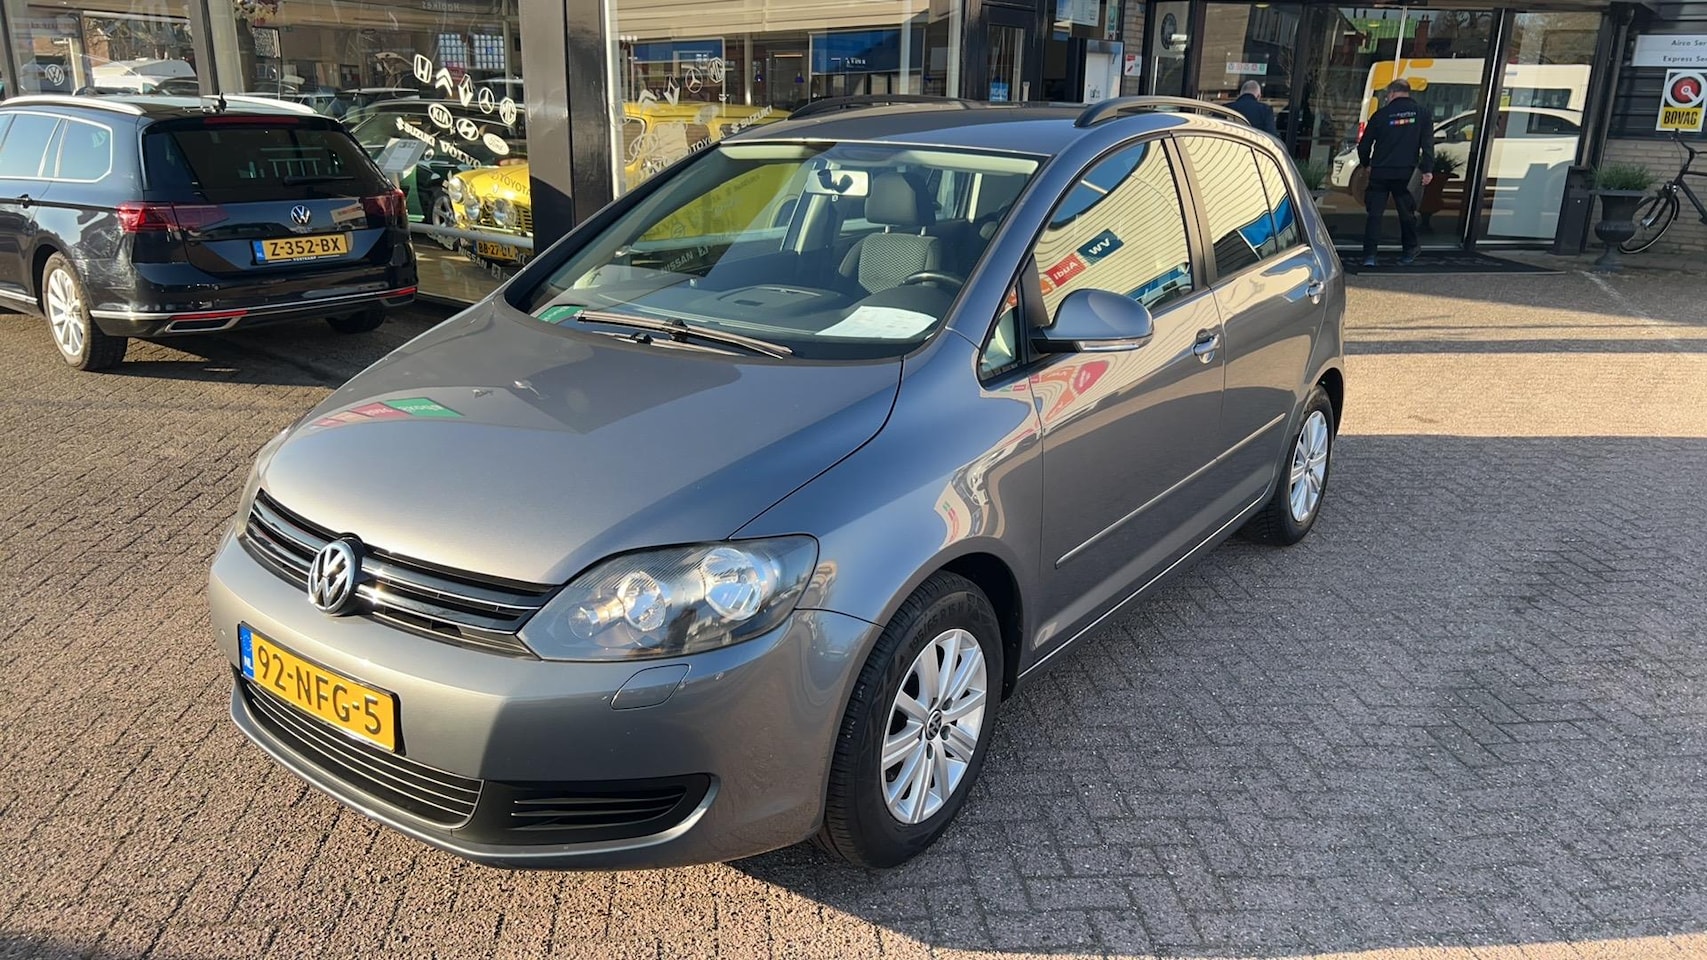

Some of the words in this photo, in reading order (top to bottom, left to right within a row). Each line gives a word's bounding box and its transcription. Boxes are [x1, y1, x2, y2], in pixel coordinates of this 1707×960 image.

[430, 106, 451, 125] KIA
[500, 99, 517, 123] MG
[741, 105, 773, 128] SUZUKI
[1663, 110, 1698, 126] BOVAG
[403, 122, 435, 147] SUZUKI
[439, 139, 481, 168] VOLVO
[270, 238, 341, 257] Z-352-BX
[243, 655, 254, 670] NL
[258, 645, 381, 735] 92-NFG-5
